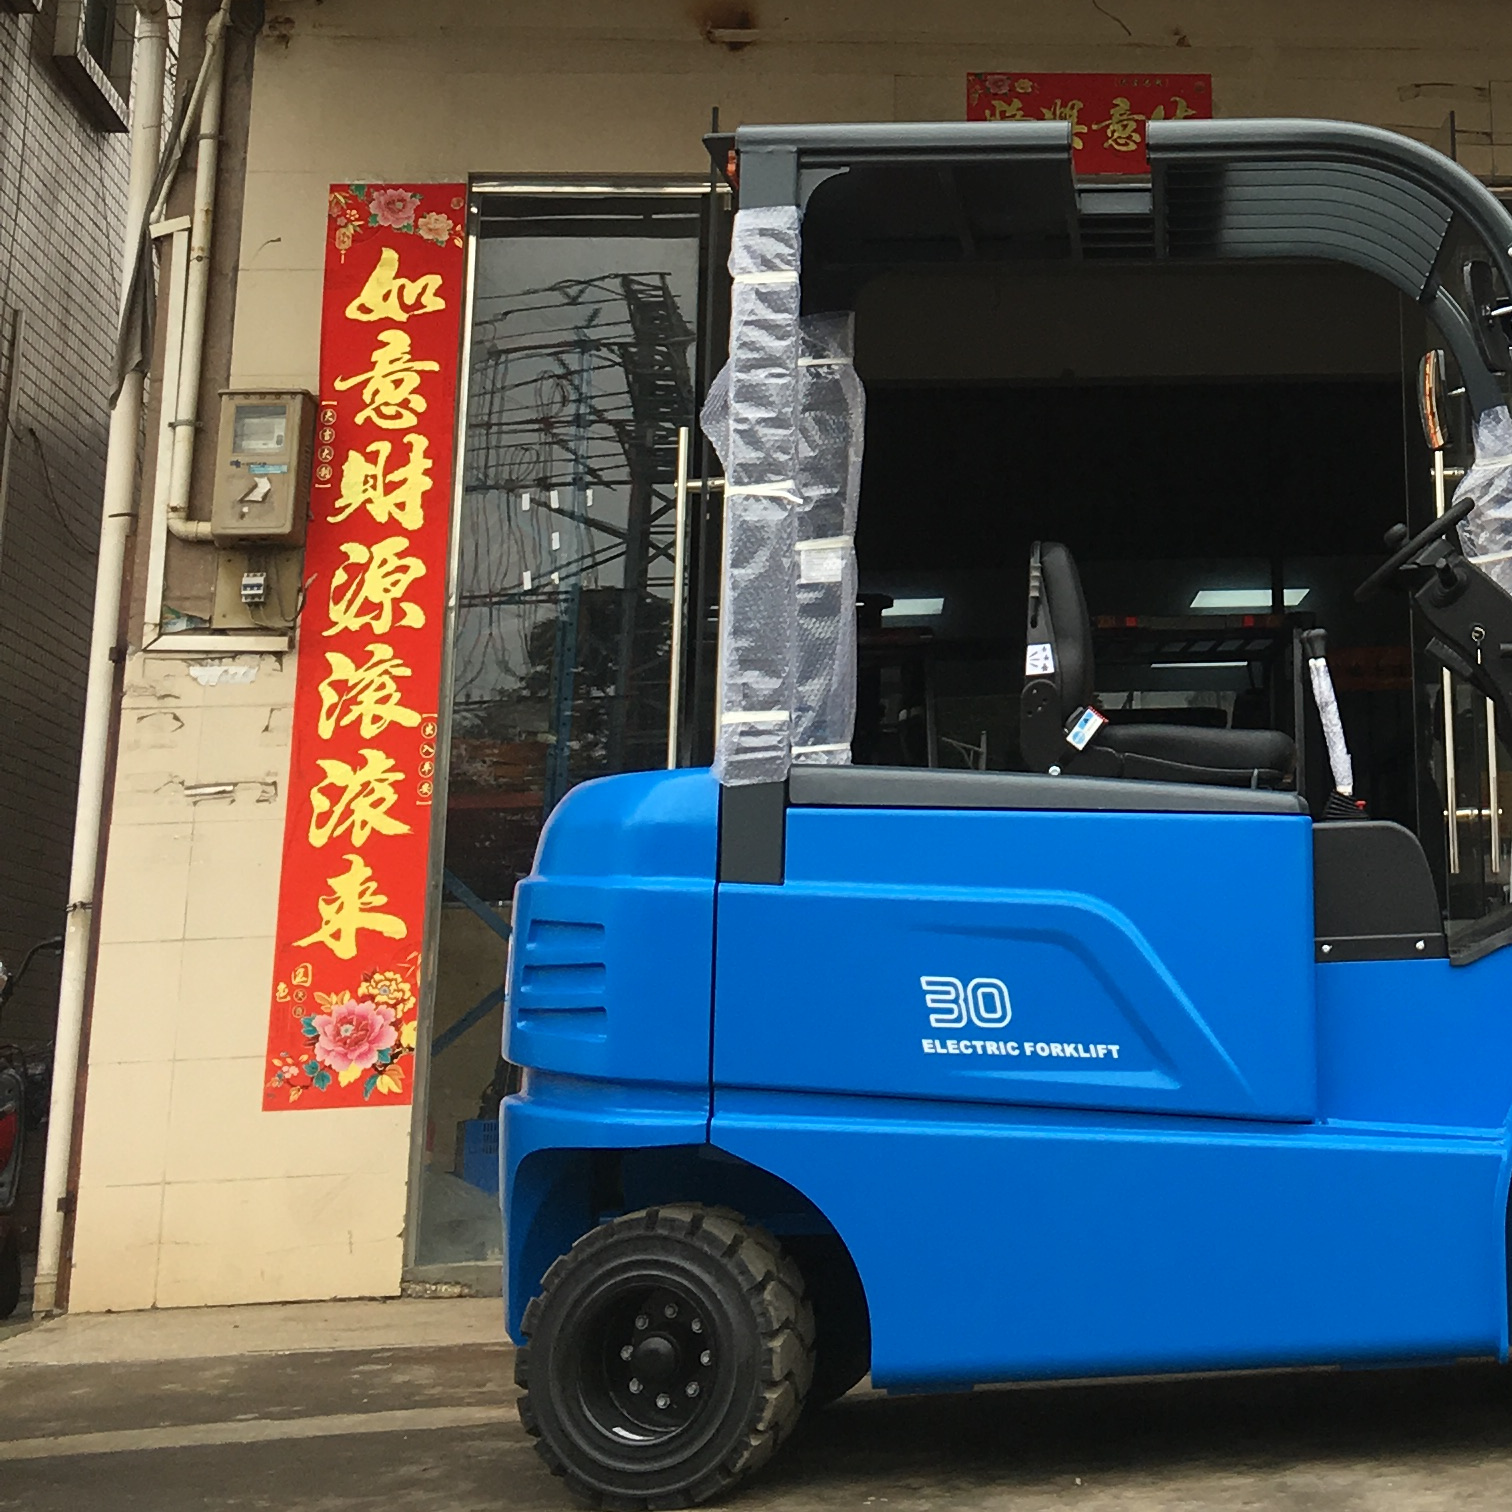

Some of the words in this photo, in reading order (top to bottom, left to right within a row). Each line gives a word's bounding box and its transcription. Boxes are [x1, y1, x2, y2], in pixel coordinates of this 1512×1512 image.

[920, 975, 1012, 1028] 30
[922, 1039, 1020, 1056] ELECTRIC
[1024, 1041, 1120, 1059] FORKLIFT
